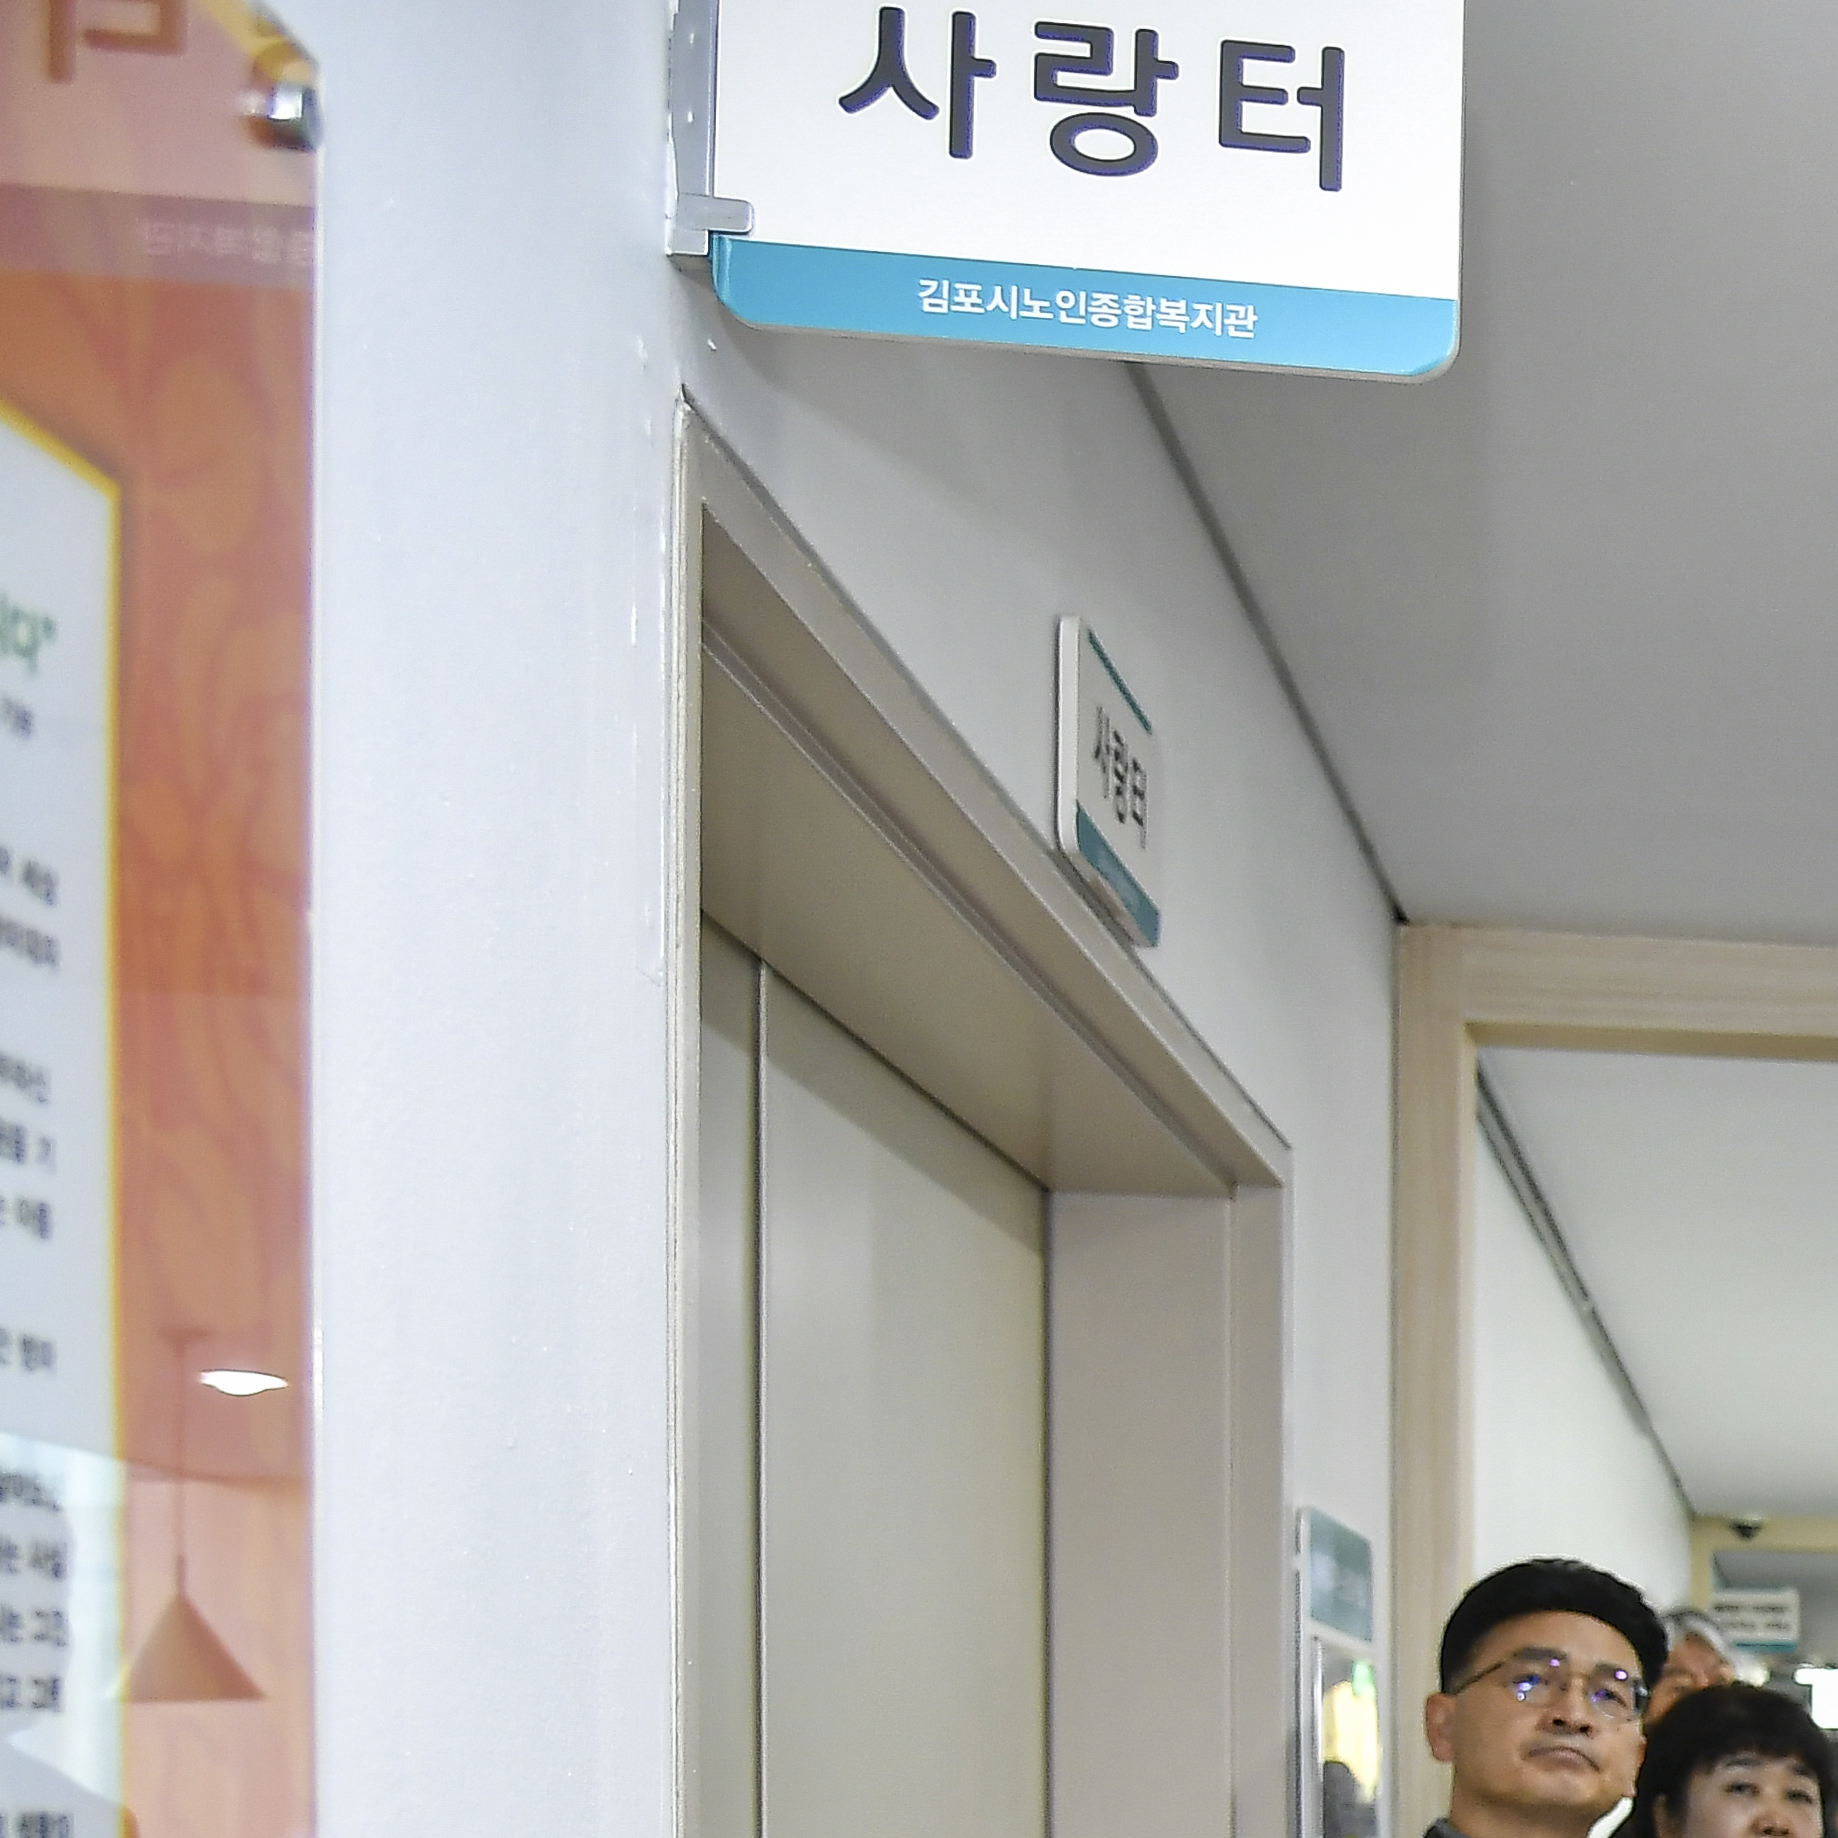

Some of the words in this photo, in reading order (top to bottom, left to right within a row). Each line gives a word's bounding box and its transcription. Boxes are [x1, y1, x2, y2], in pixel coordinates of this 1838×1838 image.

[839, 6, 1345, 192] 사랑터
[917, 277, 1258, 339] 김포시노인종합복지관
[1093, 705, 1148, 850] 사랑터
